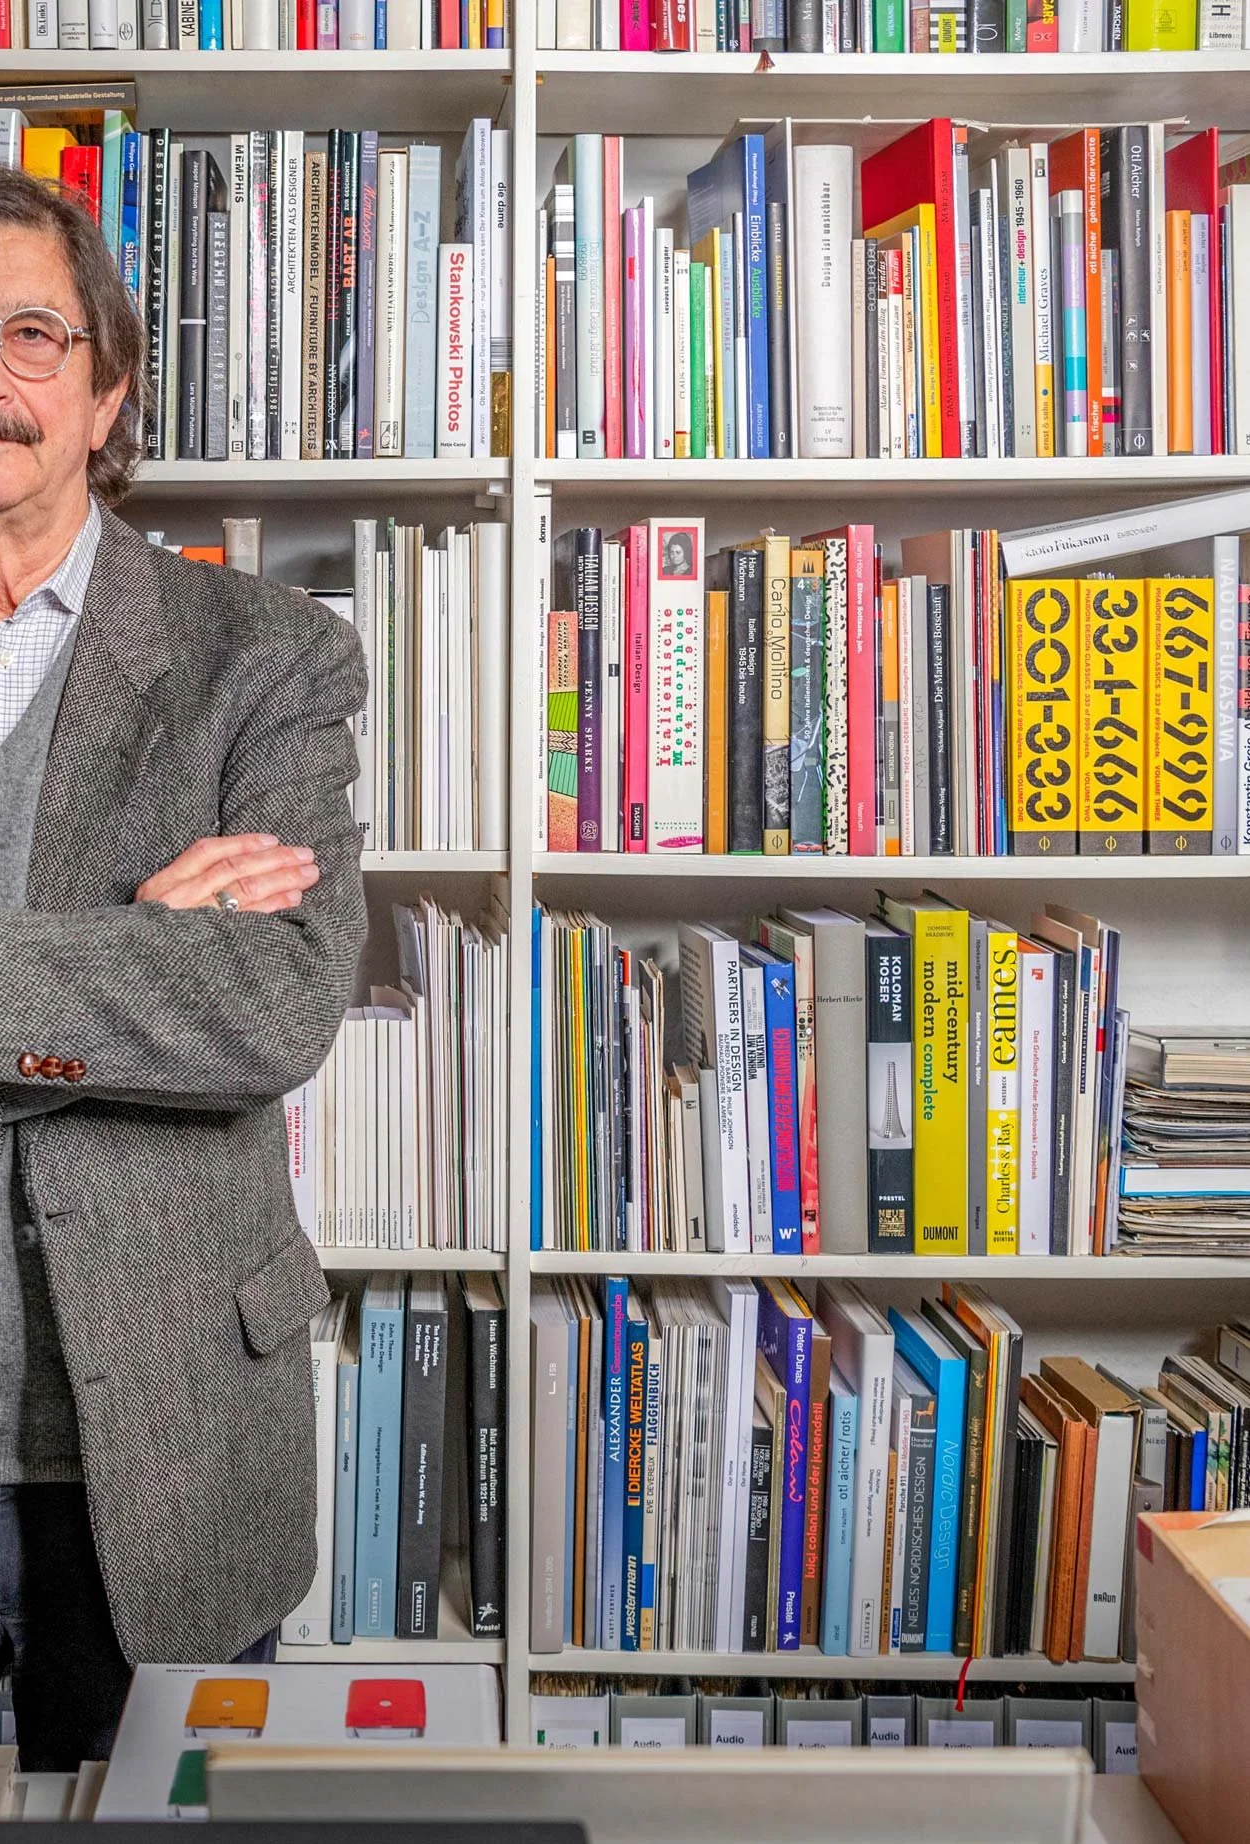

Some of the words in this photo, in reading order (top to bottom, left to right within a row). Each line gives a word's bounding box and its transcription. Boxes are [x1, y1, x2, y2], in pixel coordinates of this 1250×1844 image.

[943, 18, 952, 42] DUMONT
[1209, 31, 1232, 39] Librero
[1088, 137, 1096, 166] wüste
[1130, 145, 1142, 165] Otl
[234, 145, 244, 203] MEMPHIS
[288, 158, 298, 205] DESIGNER
[497, 181, 506, 199] die
[1130, 167, 1141, 199] Aicher
[288, 207, 297, 226] ALS
[310, 162, 320, 281] ARCHITEKTENMÖBEL
[497, 202, 506, 229] dame
[1089, 195, 1098, 223] gehen
[190, 216, 199, 246] Everything
[750, 215, 762, 262] Einblicke
[1089, 232, 1097, 260] aicher
[287, 227, 297, 293] ARCHITEKTEN
[1089, 262, 1097, 274] otl
[449, 252, 465, 361] Stankowski
[751, 267, 762, 318] Ausblicke
[1038, 268, 1049, 309] Graves
[309, 295, 319, 361] FURNITURE
[1038, 313, 1049, 361] Michael
[308, 363, 318, 378] BY
[307, 380, 317, 450] ARCHITECTS
[448, 365, 464, 433] Photos
[1091, 400, 1099, 440] s.fischer
[584, 554, 599, 593] ITALIAN
[738, 557, 747, 601] Wichmann
[748, 557, 756, 578] Hans
[584, 595, 599, 630] DESIGN
[771, 578, 787, 628] Carlo
[1219, 558, 1235, 633] NAOTO
[748, 618, 756, 642] Italien
[932, 596, 942, 638] Botschaft
[635, 633, 643, 661] Italian
[747, 647, 756, 675] Design
[933, 640, 942, 653] als
[634, 664, 643, 693] Design
[739, 668, 747, 680] bis
[771, 636, 787, 700] Mollino
[933, 655, 943, 684] Marke
[584, 680, 593, 719] PENNY
[739, 681, 747, 704] heute
[933, 686, 943, 703] Die
[1025, 588, 1071, 822] 001-333
[1164, 588, 1209, 822] 667-999
[1219, 639, 1235, 761] FUKASAWA
[585, 728, 593, 773] SPARKE
[633, 807, 641, 836] TASCHEN
[727, 960, 740, 1024] PARTNERS
[879, 956, 890, 1003] MOSER
[892, 956, 902, 1022] KOLOMAN
[923, 961, 938, 1038] modern
[943, 961, 962, 1083] mid-century
[990, 949, 1017, 1065] eames
[729, 1028, 741, 1042] IN
[730, 1045, 742, 1092] DESIGN
[920, 1043, 938, 1121] complete
[996, 1122, 1015, 1147] Ray
[294, 1170, 300, 1178] IM
[998, 1150, 1009, 1160] &
[996, 1163, 1011, 1214] Charles
[732, 1203, 740, 1238] arnoldsche
[923, 1226, 959, 1241] DUMONT
[489, 1320, 497, 1342] Hans
[611, 1294, 624, 1375] Gesamtausgabe
[795, 1327, 806, 1352] Peter
[489, 1343, 497, 1389] Wichmann
[630, 1342, 644, 1424] WELTATLAS
[794, 1354, 805, 1383] Dunas
[610, 1377, 622, 1462] ALEXANDER
[646, 1363, 660, 1446] FLAGGENBUCH
[811, 1403, 824, 1463] jugendstil
[628, 1427, 642, 1492] DIERCKE
[647, 1456, 656, 1496] DEVEREUX
[810, 1465, 820, 1485] der
[913, 1456, 926, 1501] DESIGN
[940, 1440, 959, 1502] Nordic
[489, 1465, 498, 1507] Aufbruch
[809, 1488, 819, 1511] und
[647, 1499, 655, 1514] EVE
[807, 1513, 818, 1550] colani
[910, 1505, 924, 1584] NORDISCHES
[936, 1504, 956, 1571] Design
[805, 1553, 818, 1578] luigi
[625, 1555, 638, 1636] westermann
[785, 1591, 795, 1623] Prestel
[908, 1588, 921, 1628] NEUES
[632, 1740, 661, 1750] Audio
[716, 1734, 744, 1744] Audio
[871, 1730, 900, 1742] Audio
